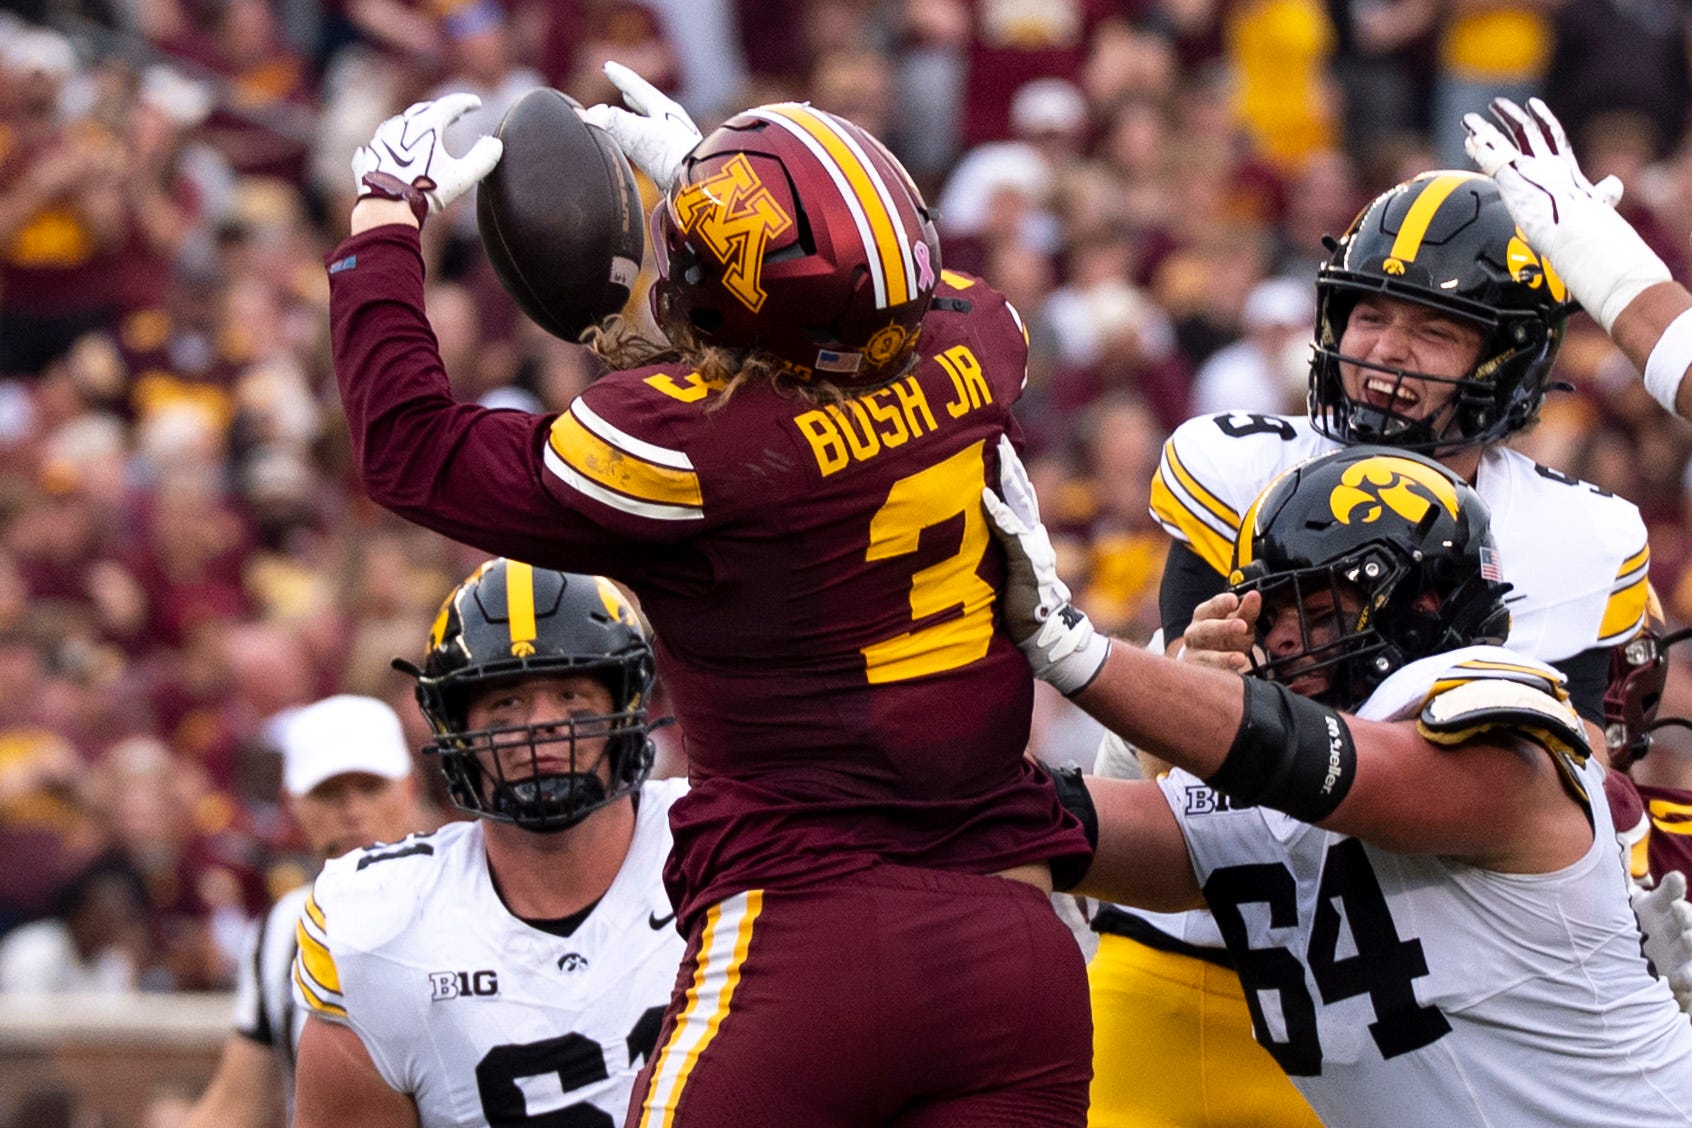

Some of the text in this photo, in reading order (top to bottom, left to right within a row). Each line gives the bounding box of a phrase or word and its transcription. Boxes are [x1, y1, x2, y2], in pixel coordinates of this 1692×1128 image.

[673, 152, 793, 314] M
[794, 345, 993, 477] BUSH JR
[860, 438, 996, 684] 3
[1203, 837, 1453, 1077] 64
